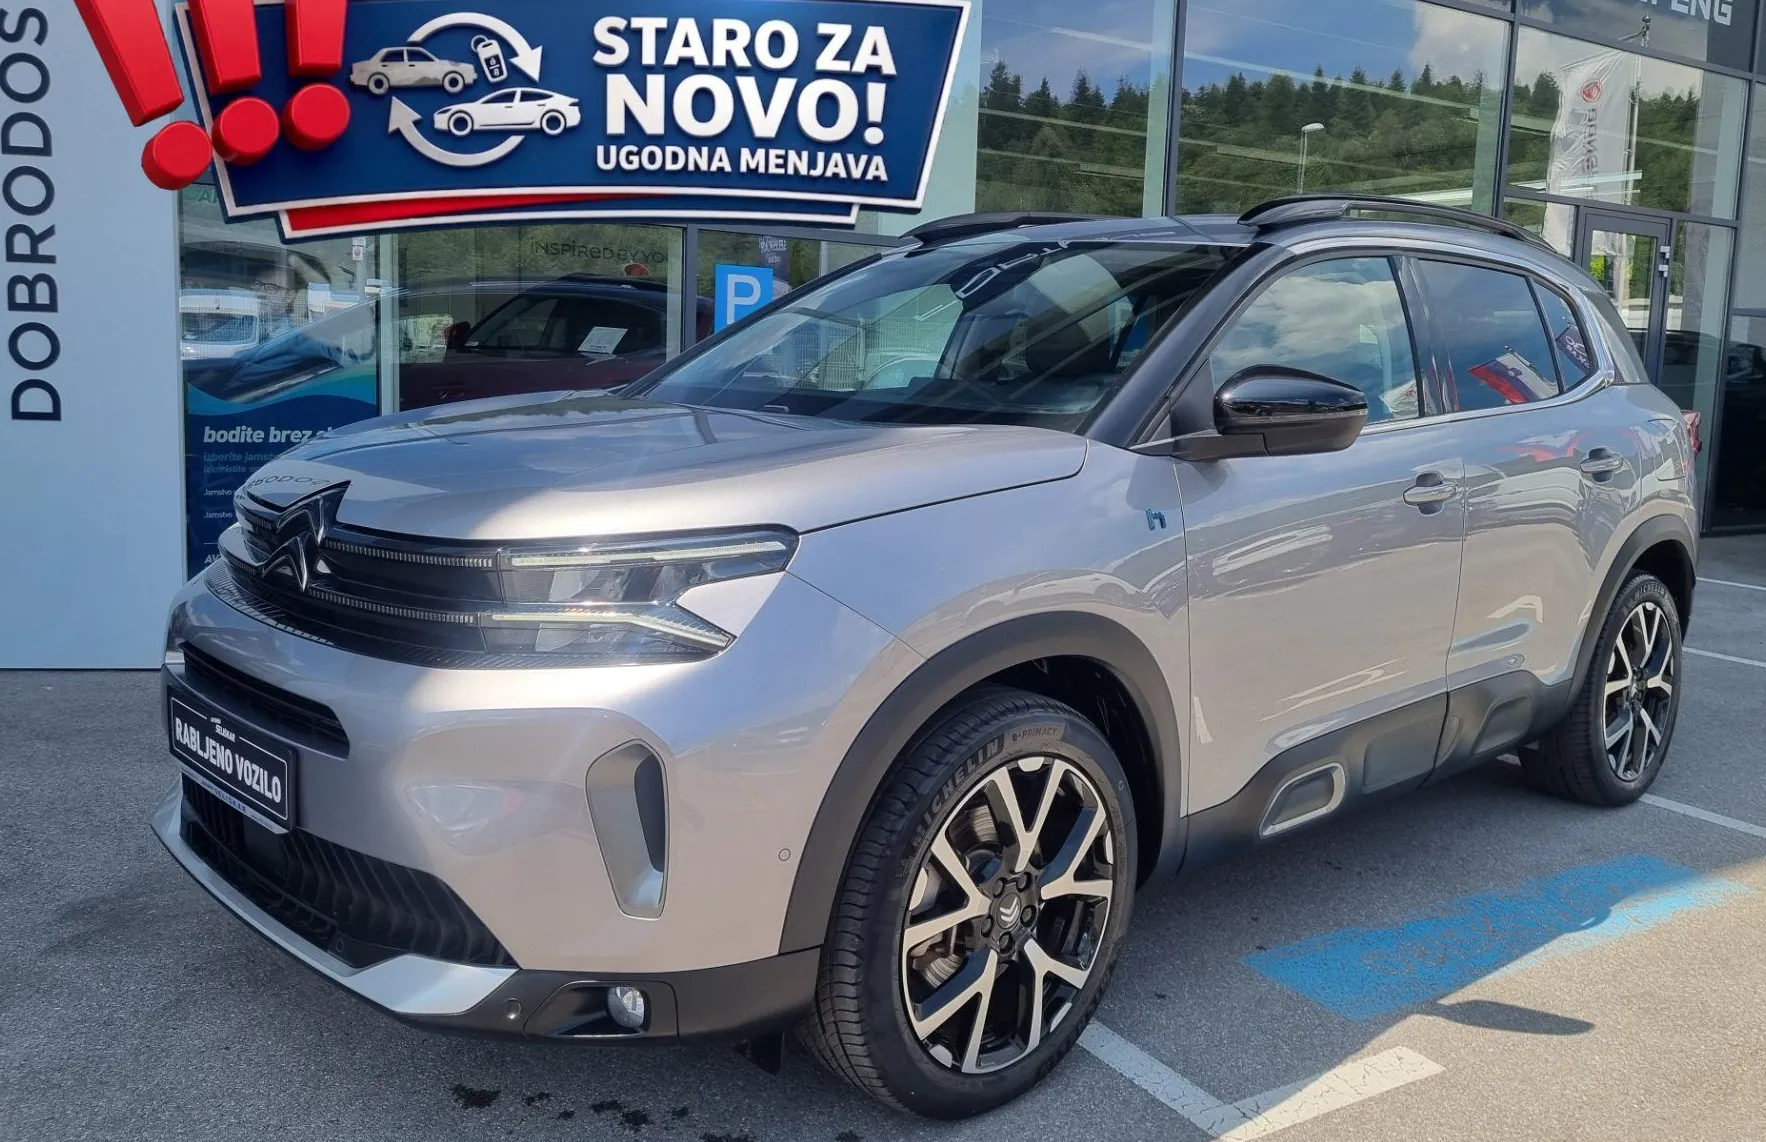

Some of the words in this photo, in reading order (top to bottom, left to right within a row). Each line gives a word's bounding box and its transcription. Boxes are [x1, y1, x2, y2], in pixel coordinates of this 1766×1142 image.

[641, 250, 669, 264] YO
[726, 273, 761, 325] P
[203, 425, 265, 443] bodite
[268, 427, 313, 444] brez
[175, 716, 233, 775] RABLJENO
[235, 753, 282, 803] VOZILO
[910, 736, 1001, 847] MICHELIN
